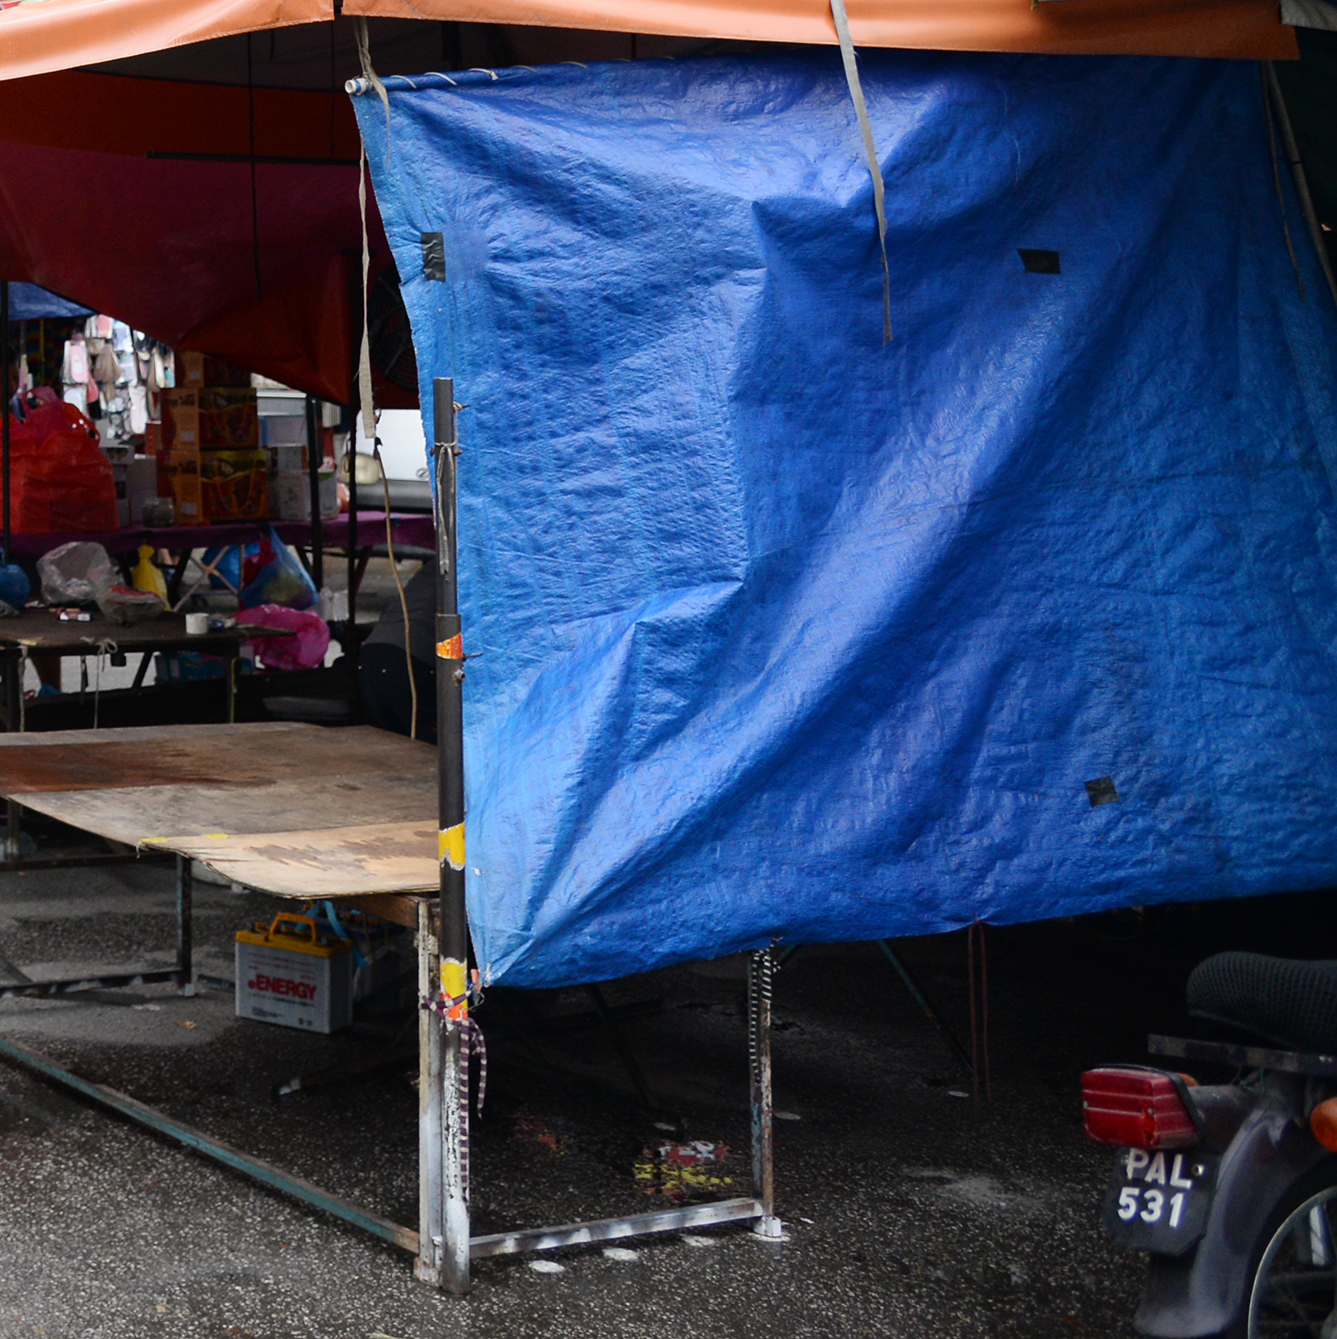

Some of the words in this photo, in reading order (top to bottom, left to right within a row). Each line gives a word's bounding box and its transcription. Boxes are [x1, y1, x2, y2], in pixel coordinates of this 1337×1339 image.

[255, 973, 318, 1002] ENERGY
[1126, 1147, 1193, 1189] PAL
[1117, 1186, 1186, 1230] 531
